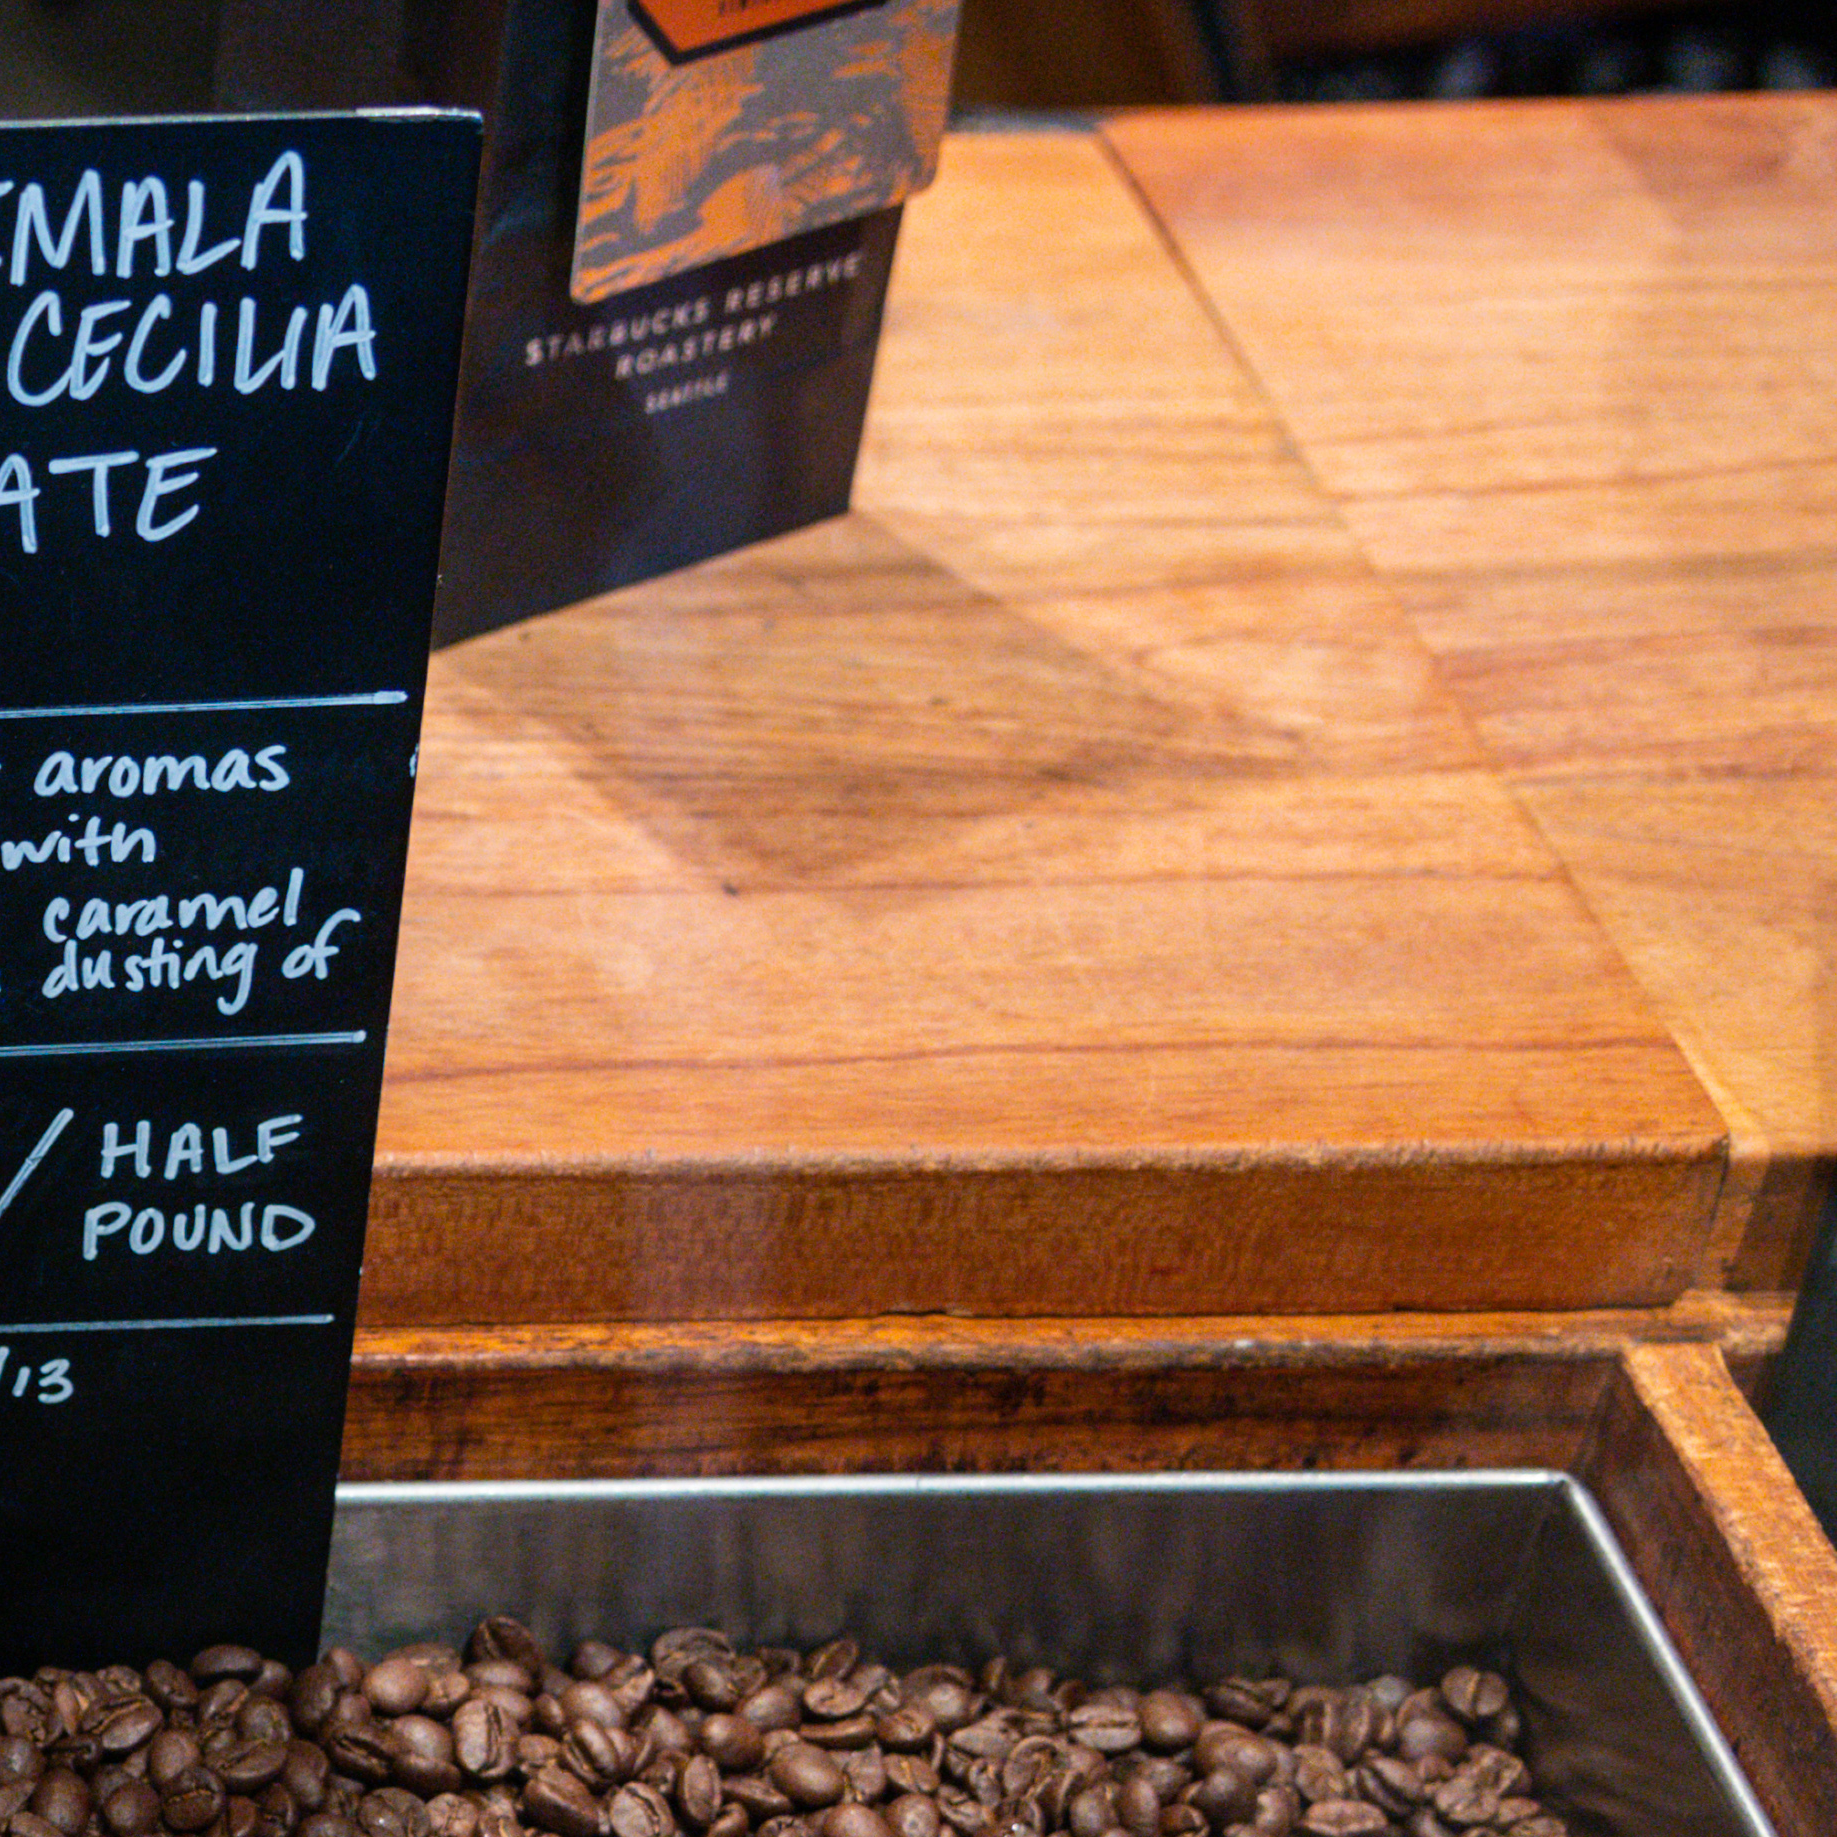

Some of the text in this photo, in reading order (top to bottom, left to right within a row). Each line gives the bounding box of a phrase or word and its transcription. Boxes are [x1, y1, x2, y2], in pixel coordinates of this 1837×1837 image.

[525, 251, 862, 366] STARBUCKS RESERVE
[7, 285, 376, 407] CECILIA
[615, 312, 776, 380] ROASTERY
[34, 745, 291, 798] aromas
[2, 814, 155, 872] with
[44, 868, 303, 940] caramel
[43, 939, 257, 1014] dusting
[282, 910, 361, 980] of
[101, 1114, 302, 1181] HALF
[83, 1203, 315, 1260] POUND
